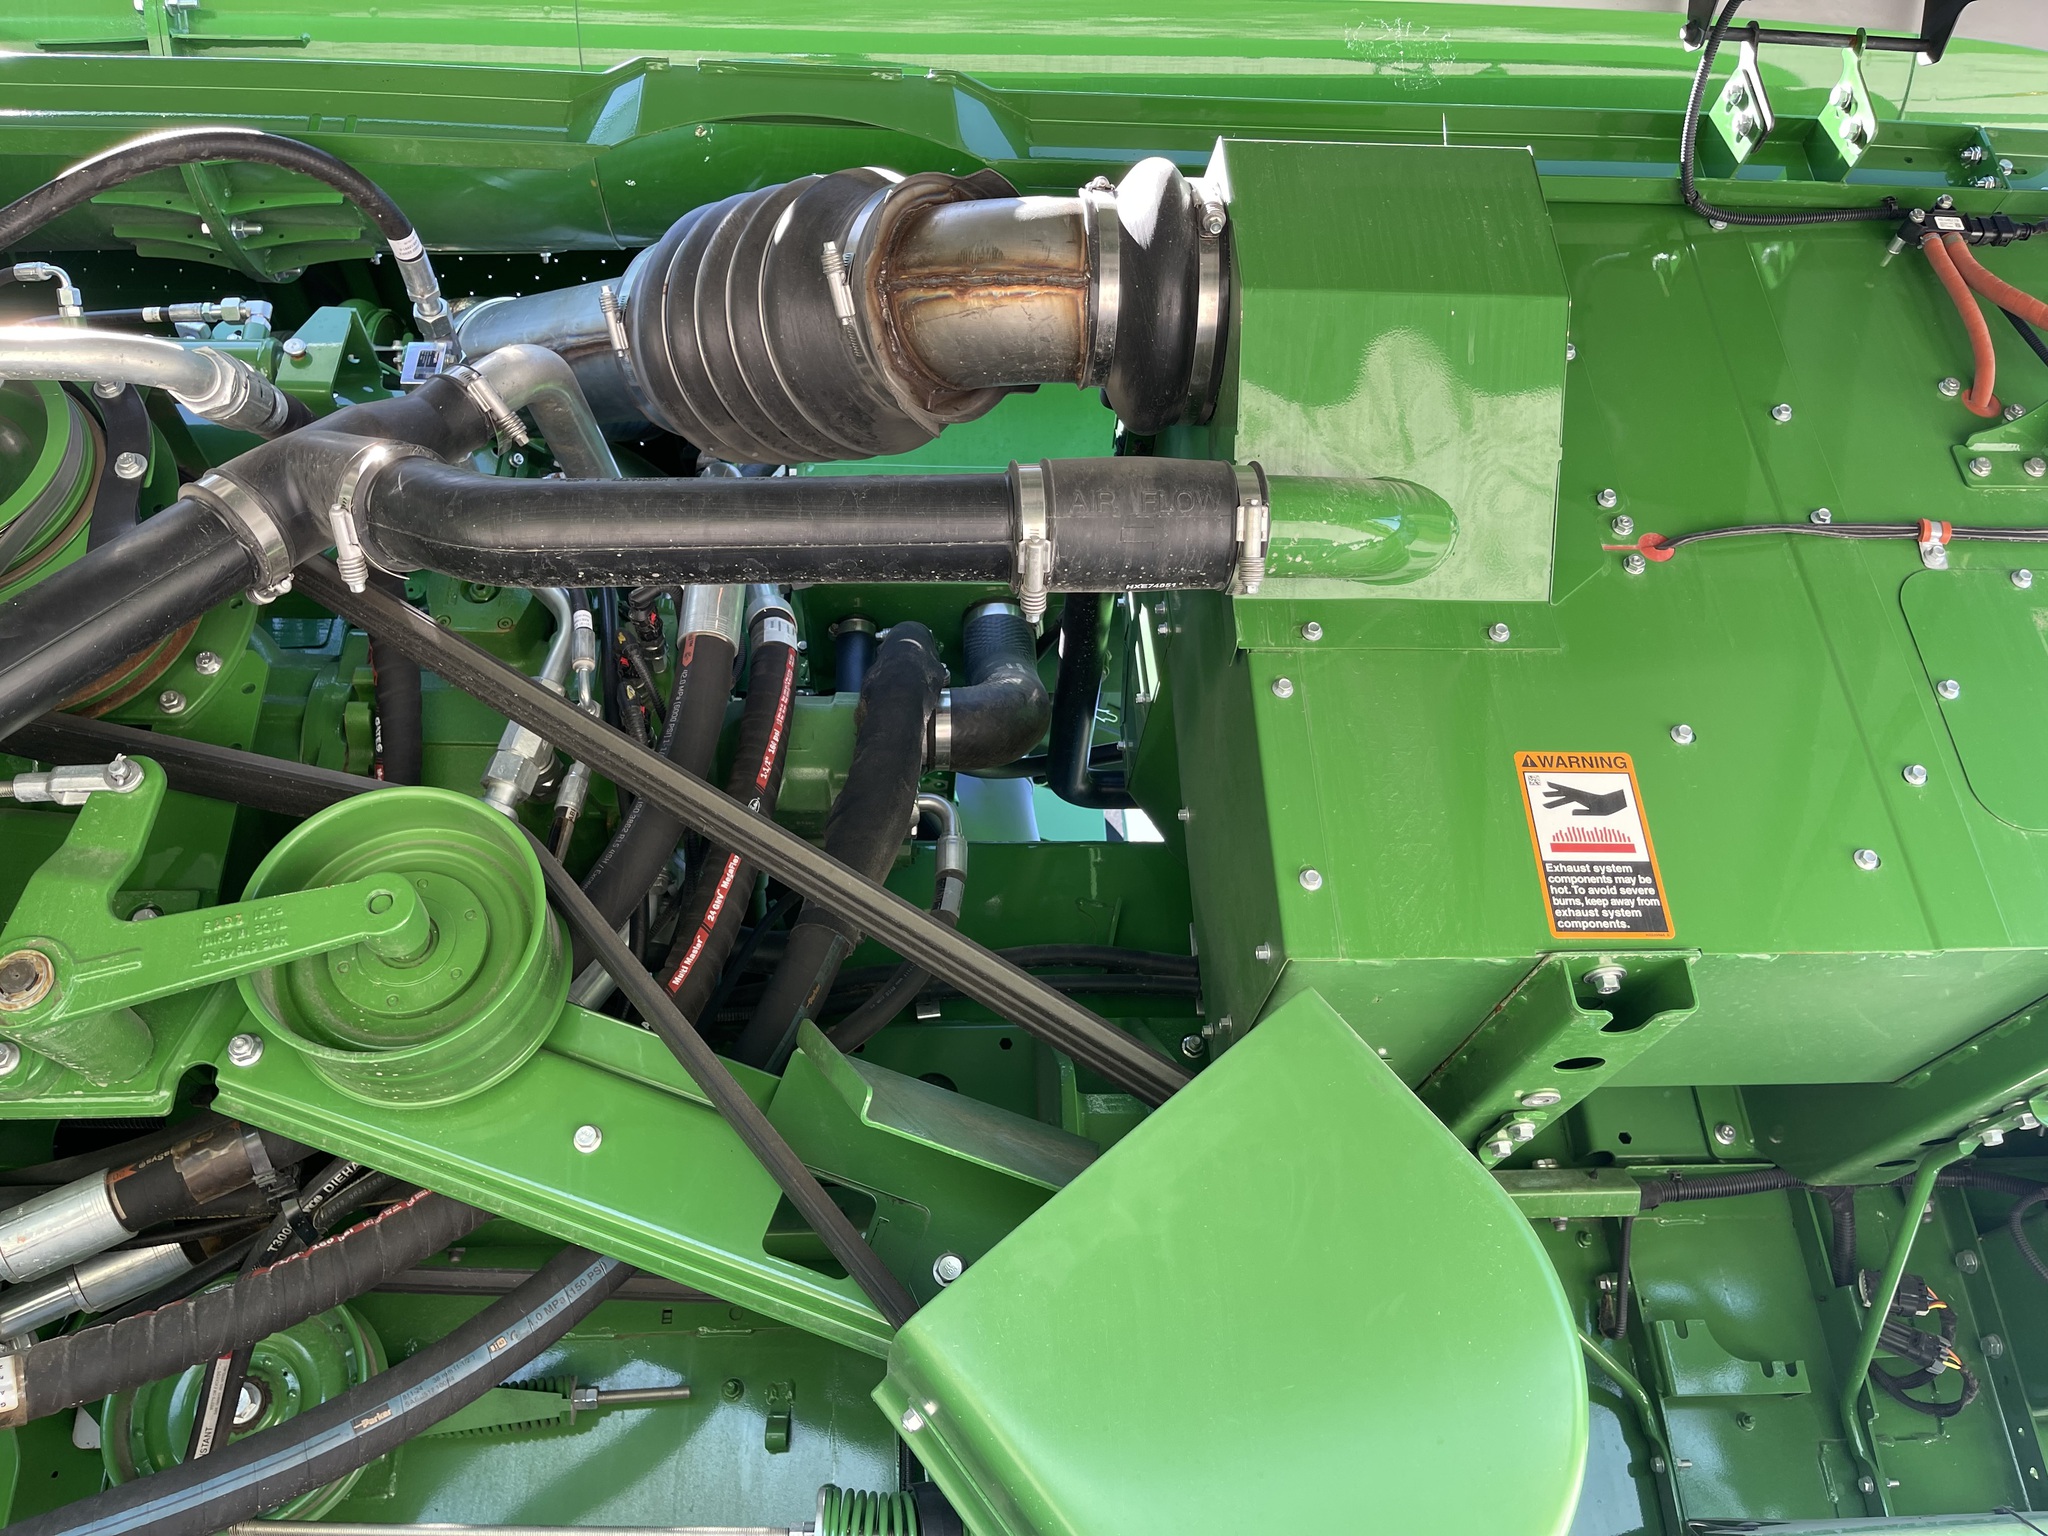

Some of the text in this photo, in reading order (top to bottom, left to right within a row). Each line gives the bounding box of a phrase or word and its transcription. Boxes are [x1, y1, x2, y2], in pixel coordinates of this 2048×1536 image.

[1069, 489, 1222, 513] AIR FLOW
[375, 716, 383, 753] GATES
[1537, 755, 1628, 769] WARNING
[1545, 863, 1633, 875] Exhaust system
[1548, 875, 1652, 886] components may be
[1550, 885, 1655, 895] hot. To avoid severe
[1552, 896, 1660, 908] burns, keep away from
[1555, 908, 1642, 919] exhaust system
[1557, 920, 1630, 930] components.
[672, 965, 689, 986] Multi
[707, 910, 717, 922] 24
[543, 1299, 566, 1316] MPa
[361, 1408, 392, 1429] Parker
